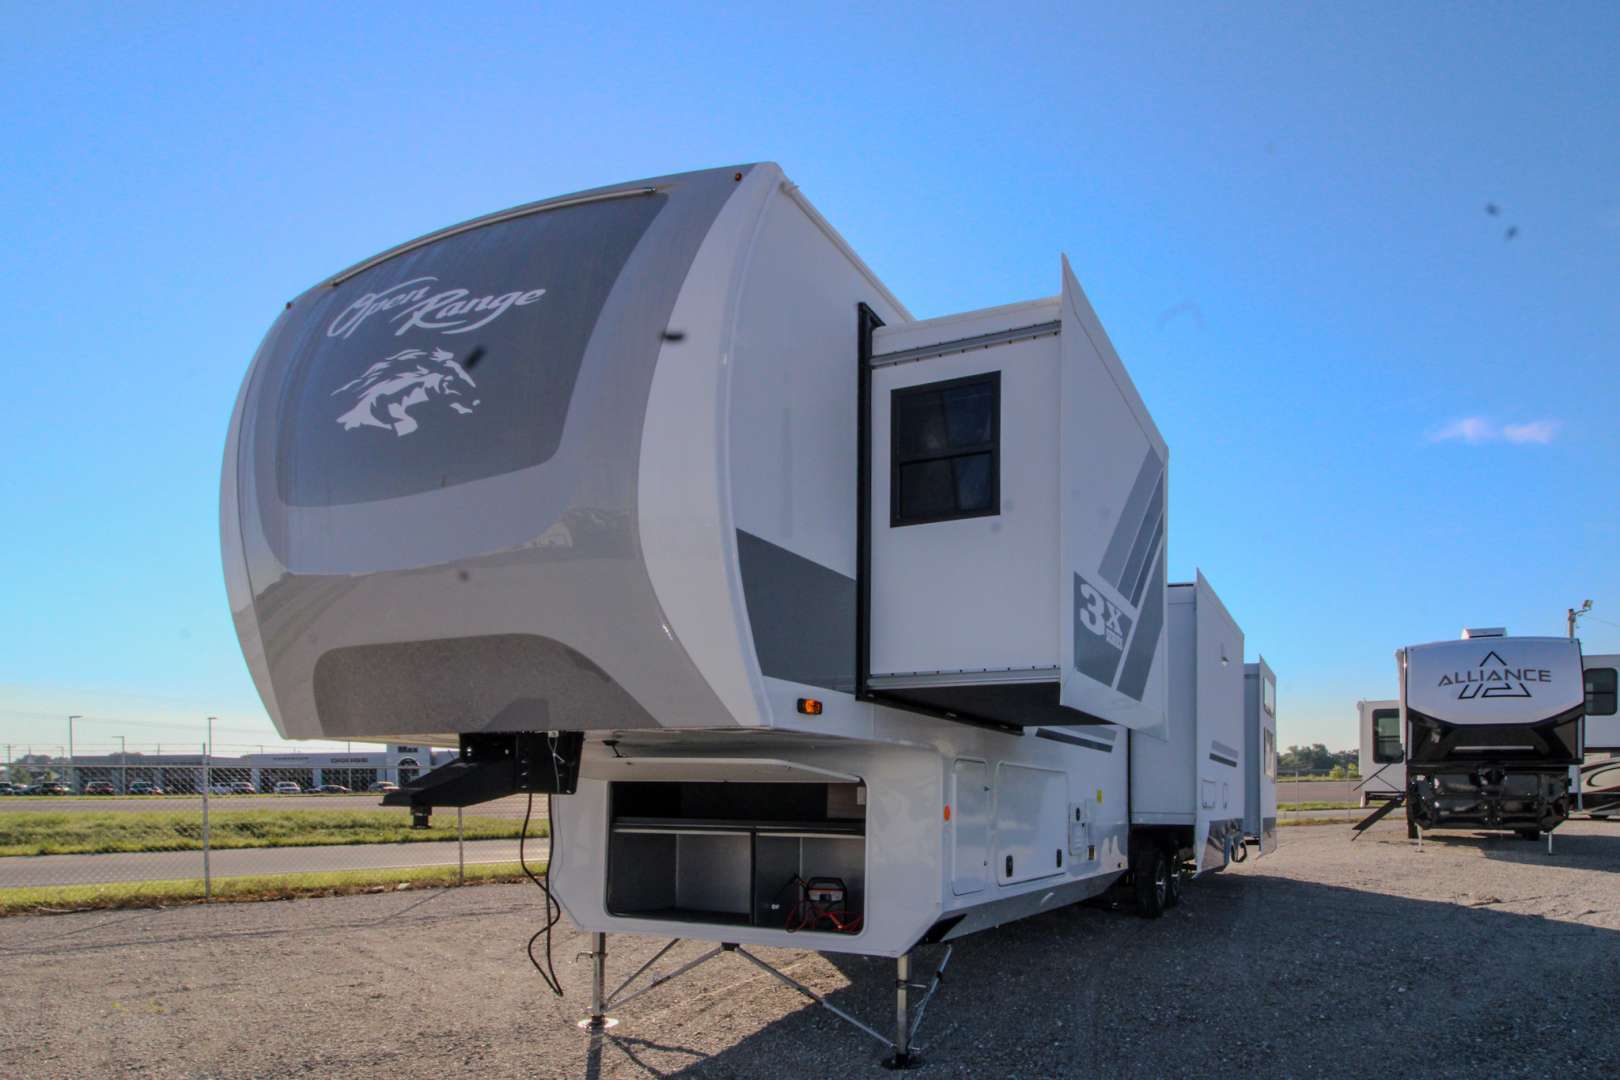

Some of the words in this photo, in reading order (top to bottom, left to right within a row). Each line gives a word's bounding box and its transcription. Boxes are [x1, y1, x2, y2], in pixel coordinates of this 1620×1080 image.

[327, 276, 438, 340] Open
[390, 288, 547, 336] Range
[1438, 668, 1552, 687] ALLIANCE
